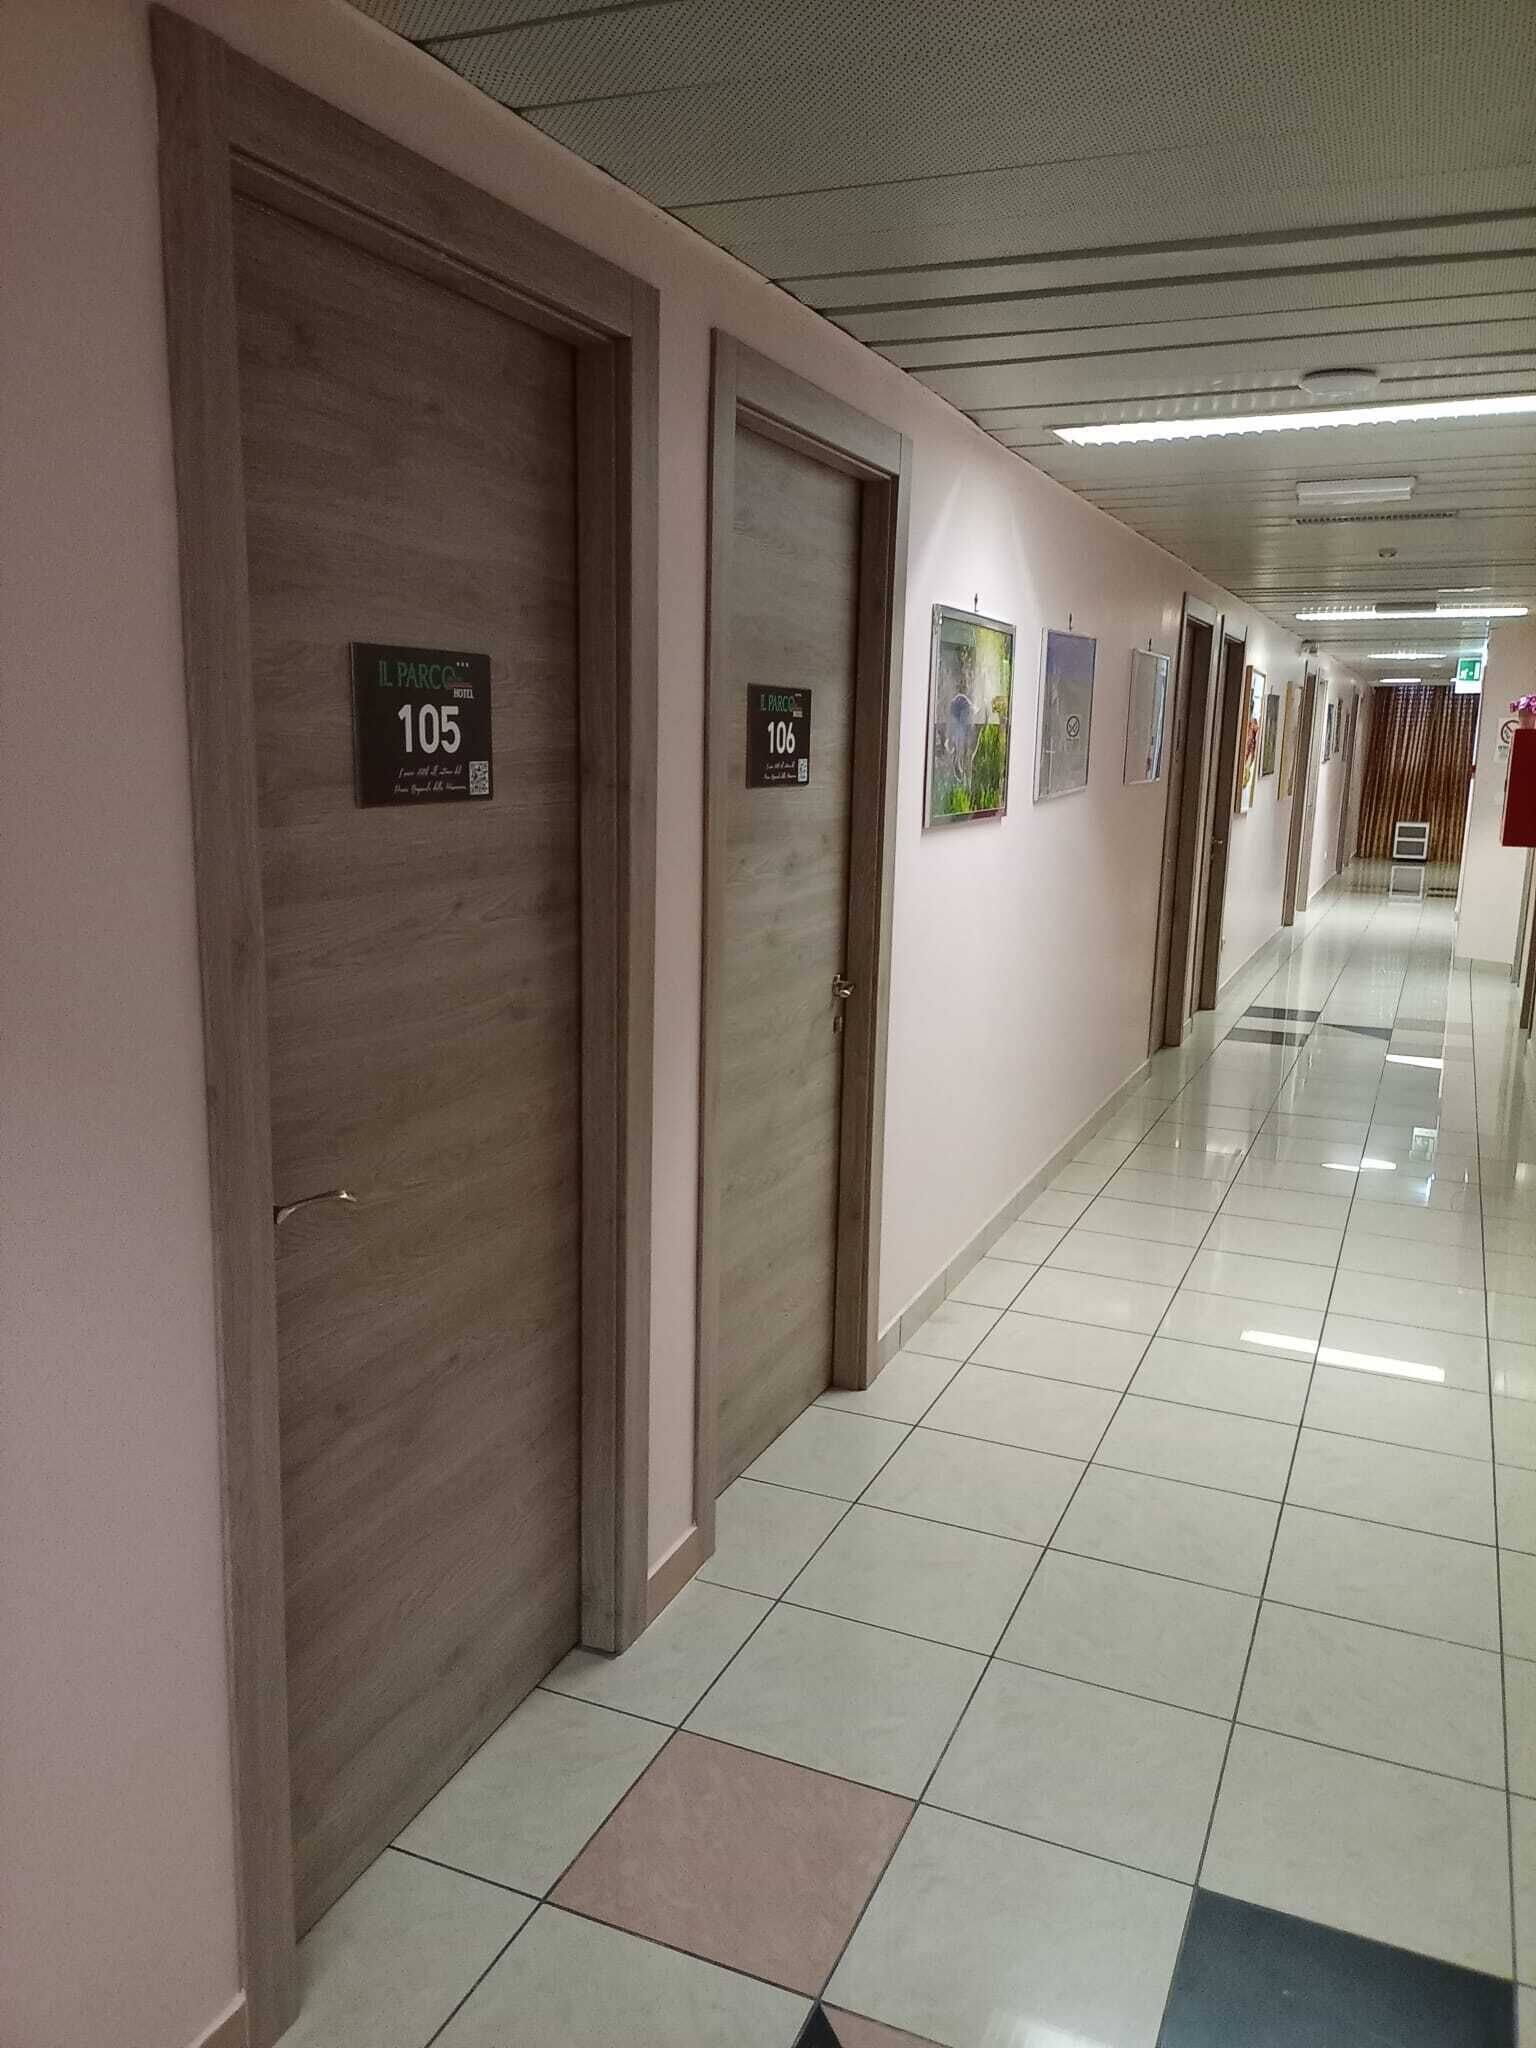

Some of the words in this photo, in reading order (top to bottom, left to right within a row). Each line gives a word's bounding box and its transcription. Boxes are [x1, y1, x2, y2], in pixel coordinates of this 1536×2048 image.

[378, 660, 392, 687] IL
[397, 662, 457, 690] PARCO
[453, 688, 474, 699] HOTEL
[768, 694, 796, 712] PARCO
[398, 703, 461, 754] 105
[767, 721, 796, 754] 106
